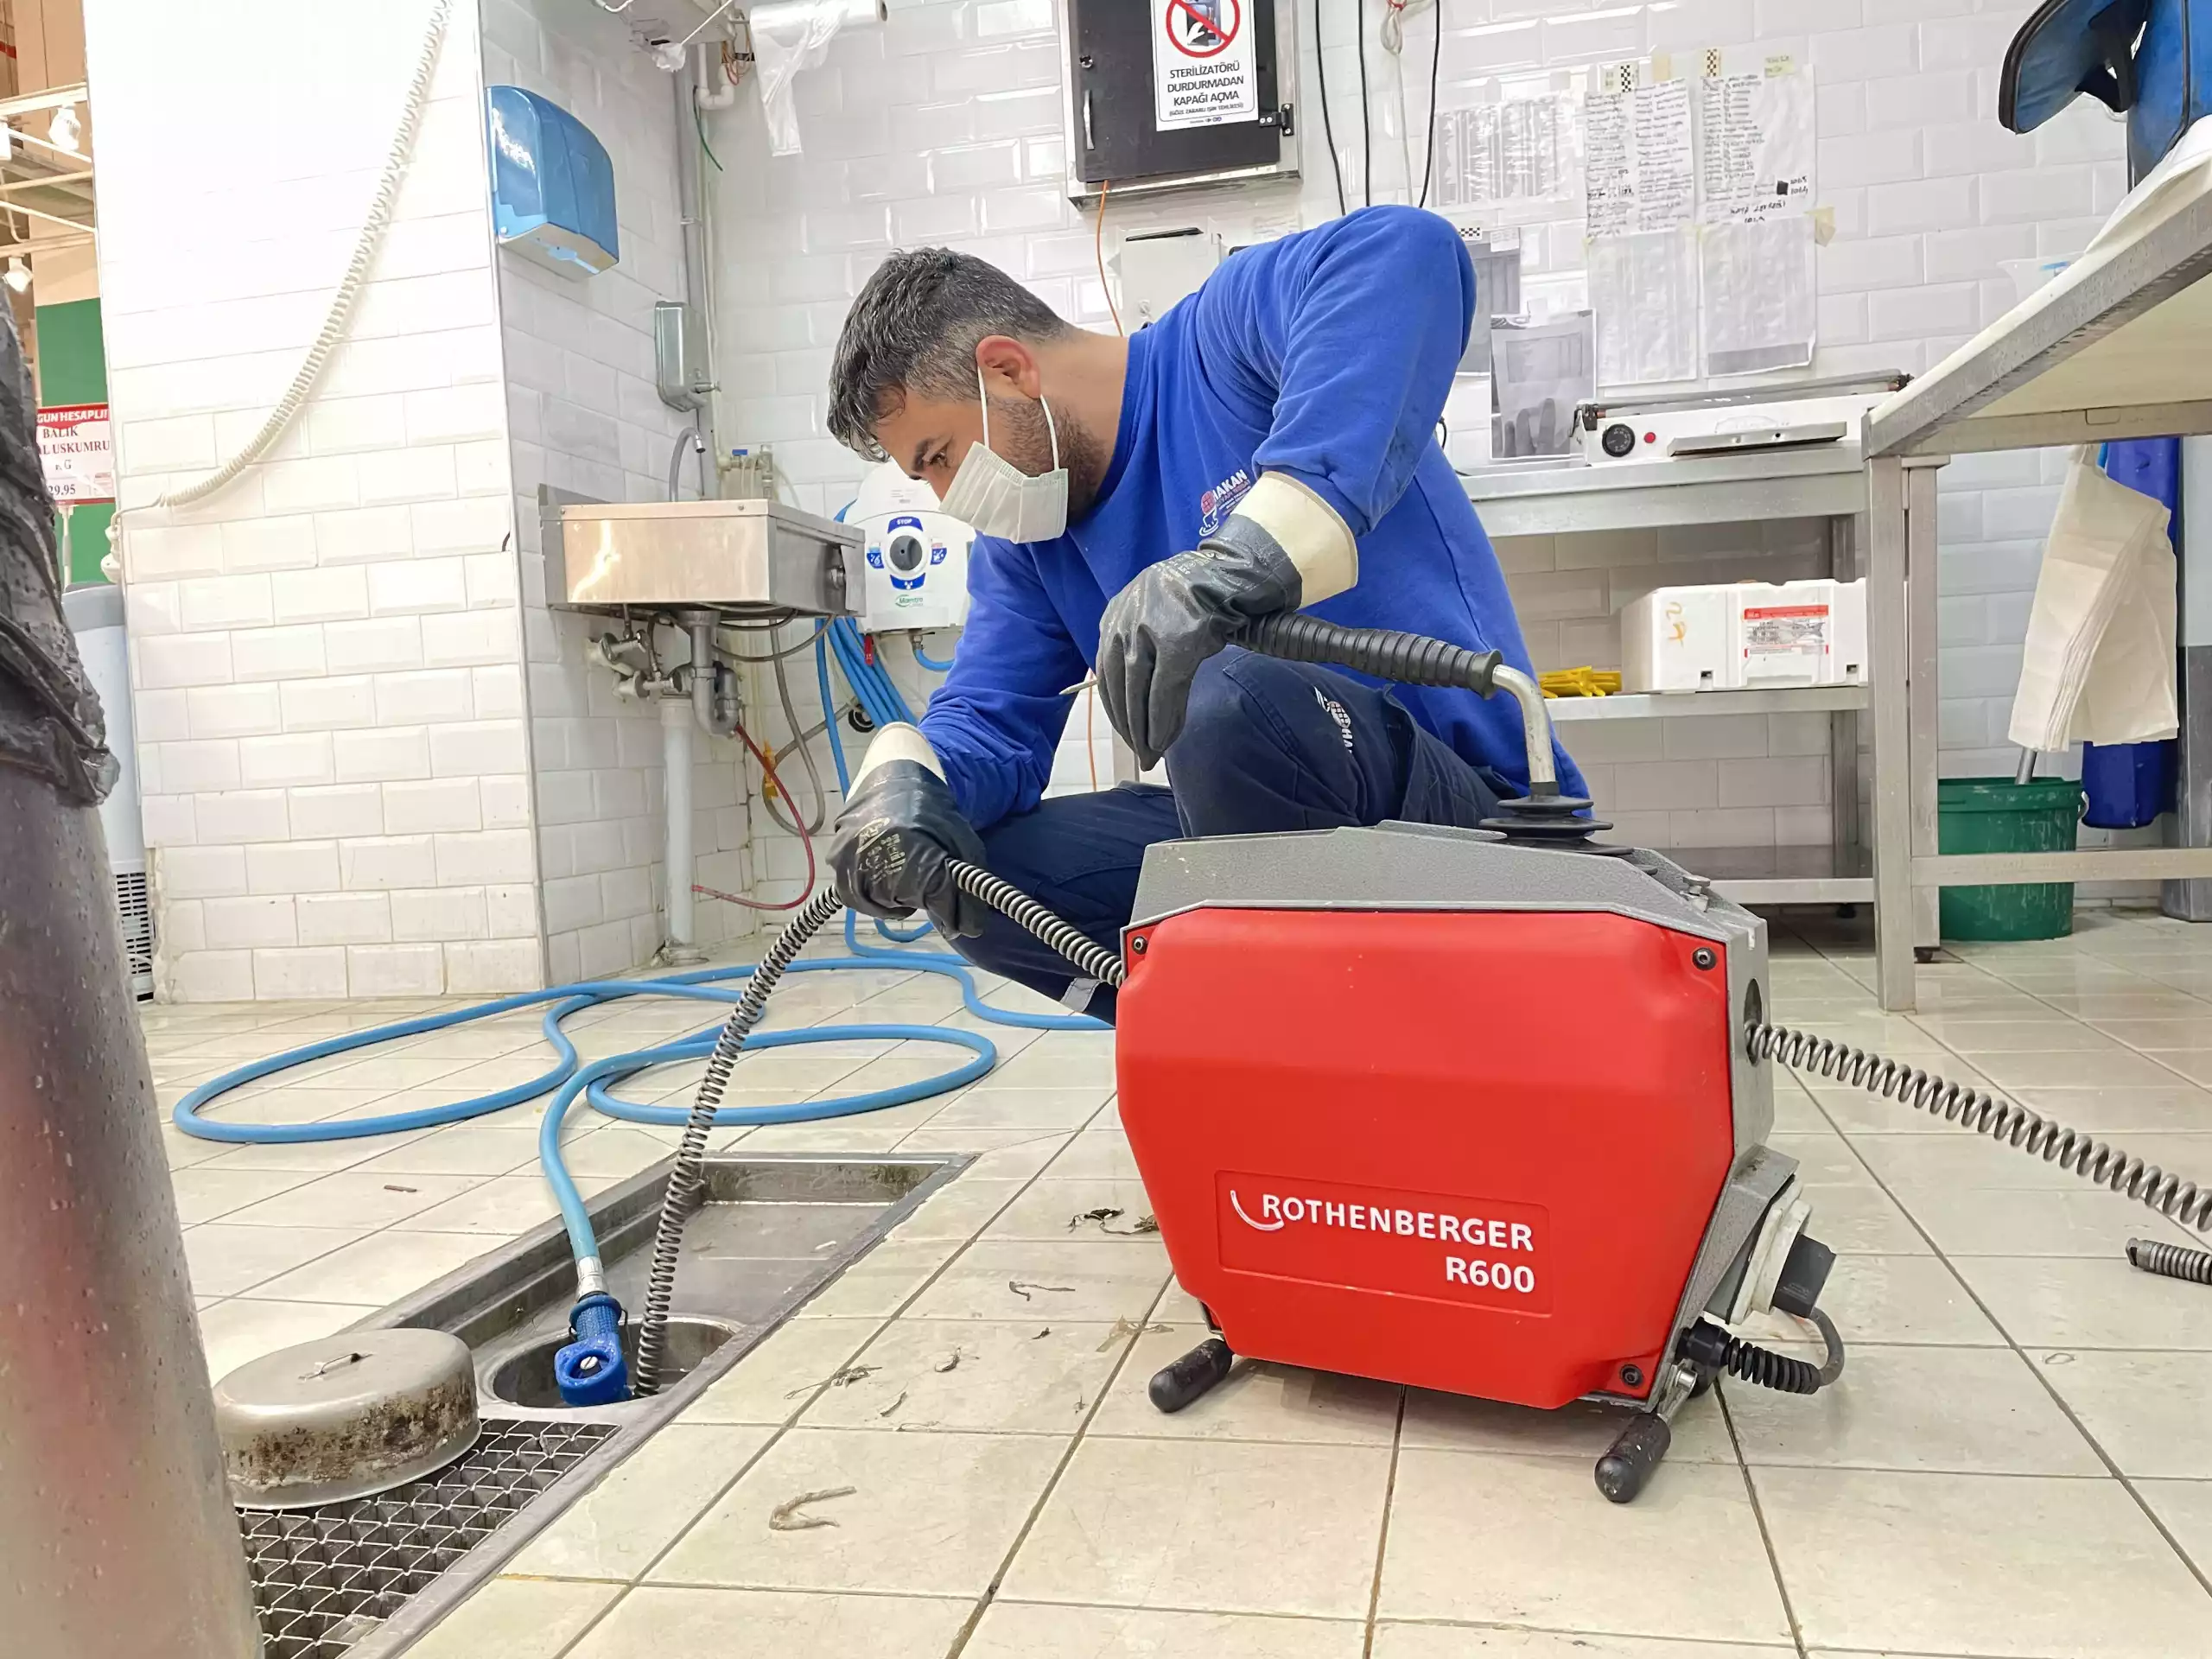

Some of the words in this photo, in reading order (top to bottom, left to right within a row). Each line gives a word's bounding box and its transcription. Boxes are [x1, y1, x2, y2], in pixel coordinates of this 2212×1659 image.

[1170, 60, 1240, 79] STERİLİZATÖRÜ
[1167, 75, 1244, 92] DURDURMADAN
[1173, 92, 1208, 106] KAPAĞI
[1211, 91, 1240, 103] AÇMA
[43, 426, 79, 439] BALIK
[53, 441, 111, 454] USKUMRU
[1262, 1193, 1535, 1252] ROTHENBERGER
[1446, 1256, 1535, 1294] R600
